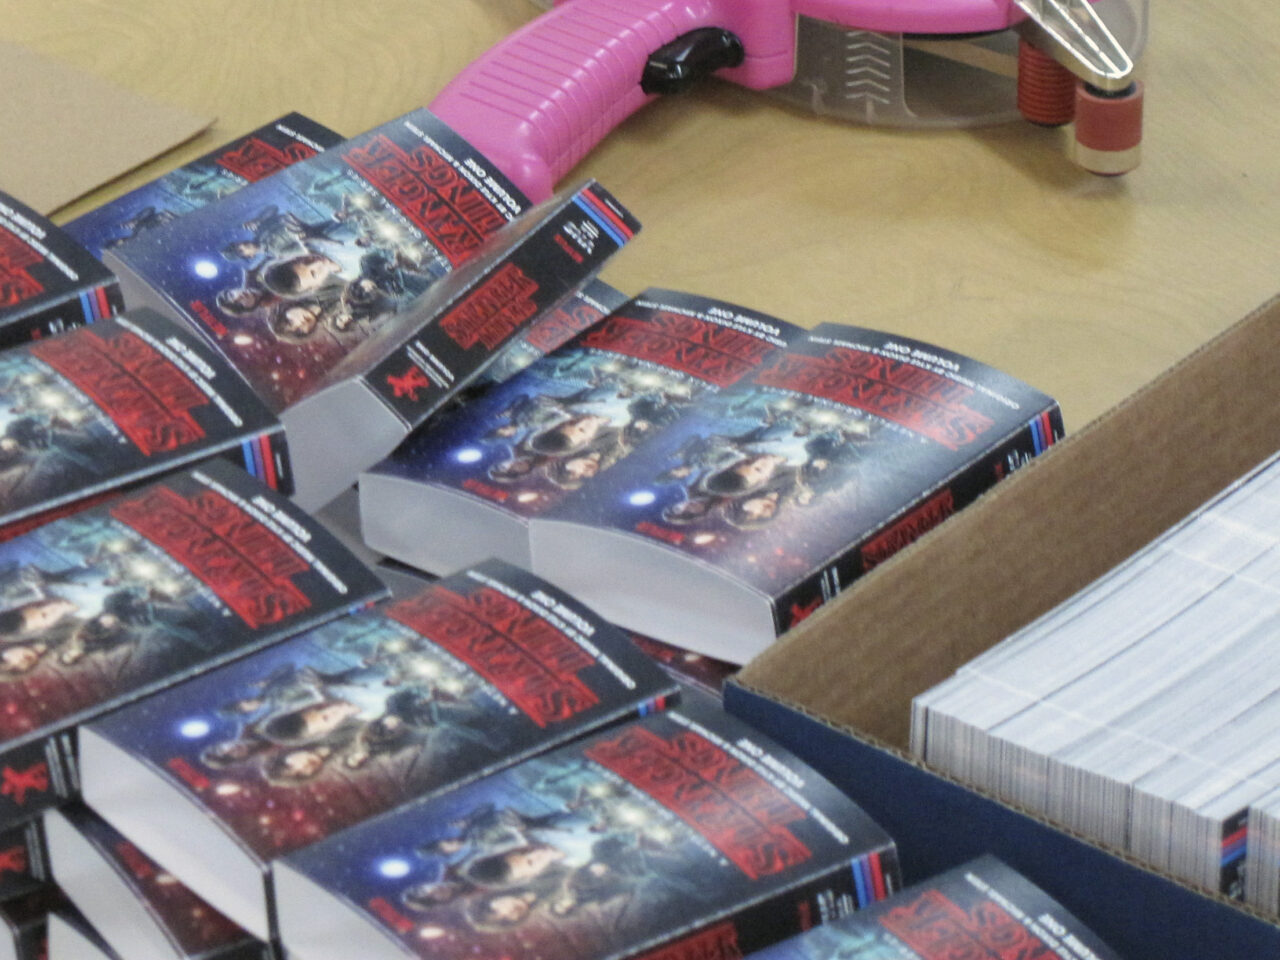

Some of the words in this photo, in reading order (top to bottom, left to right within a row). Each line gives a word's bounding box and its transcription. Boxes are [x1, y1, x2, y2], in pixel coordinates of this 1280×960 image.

[462, 157, 487, 178] ONE
[339, 133, 484, 267] RANGER
[482, 175, 522, 214] VOLUME
[707, 307, 733, 319] ONE
[733, 314, 780, 335] VOLUME
[576, 316, 756, 388] RANGER
